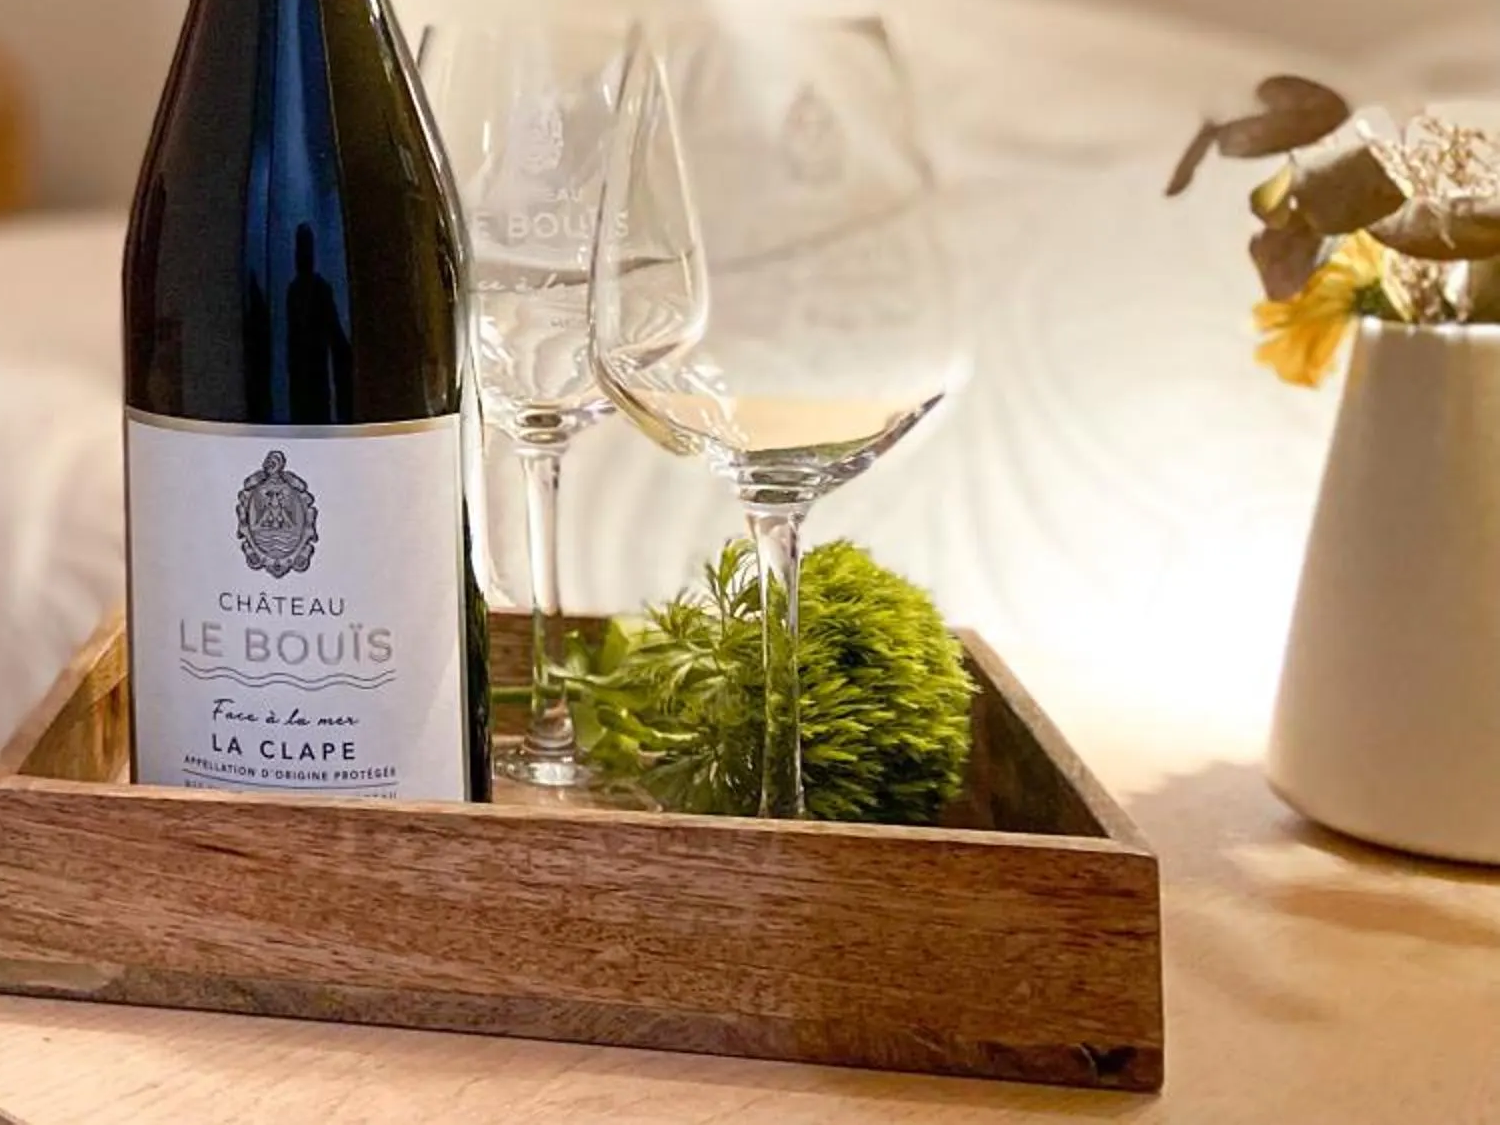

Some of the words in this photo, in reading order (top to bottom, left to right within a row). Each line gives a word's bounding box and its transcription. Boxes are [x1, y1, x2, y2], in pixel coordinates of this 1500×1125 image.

[218, 591, 345, 617] CHÂTEAU
[179, 618, 224, 658] LE
[244, 623, 394, 666] BOUÏS
[212, 697, 259, 722] Face
[264, 709, 280, 725] à
[283, 707, 312, 727] la
[316, 714, 359, 727] mer
[211, 732, 243, 755] LA
[259, 739, 357, 762] CLAPE
